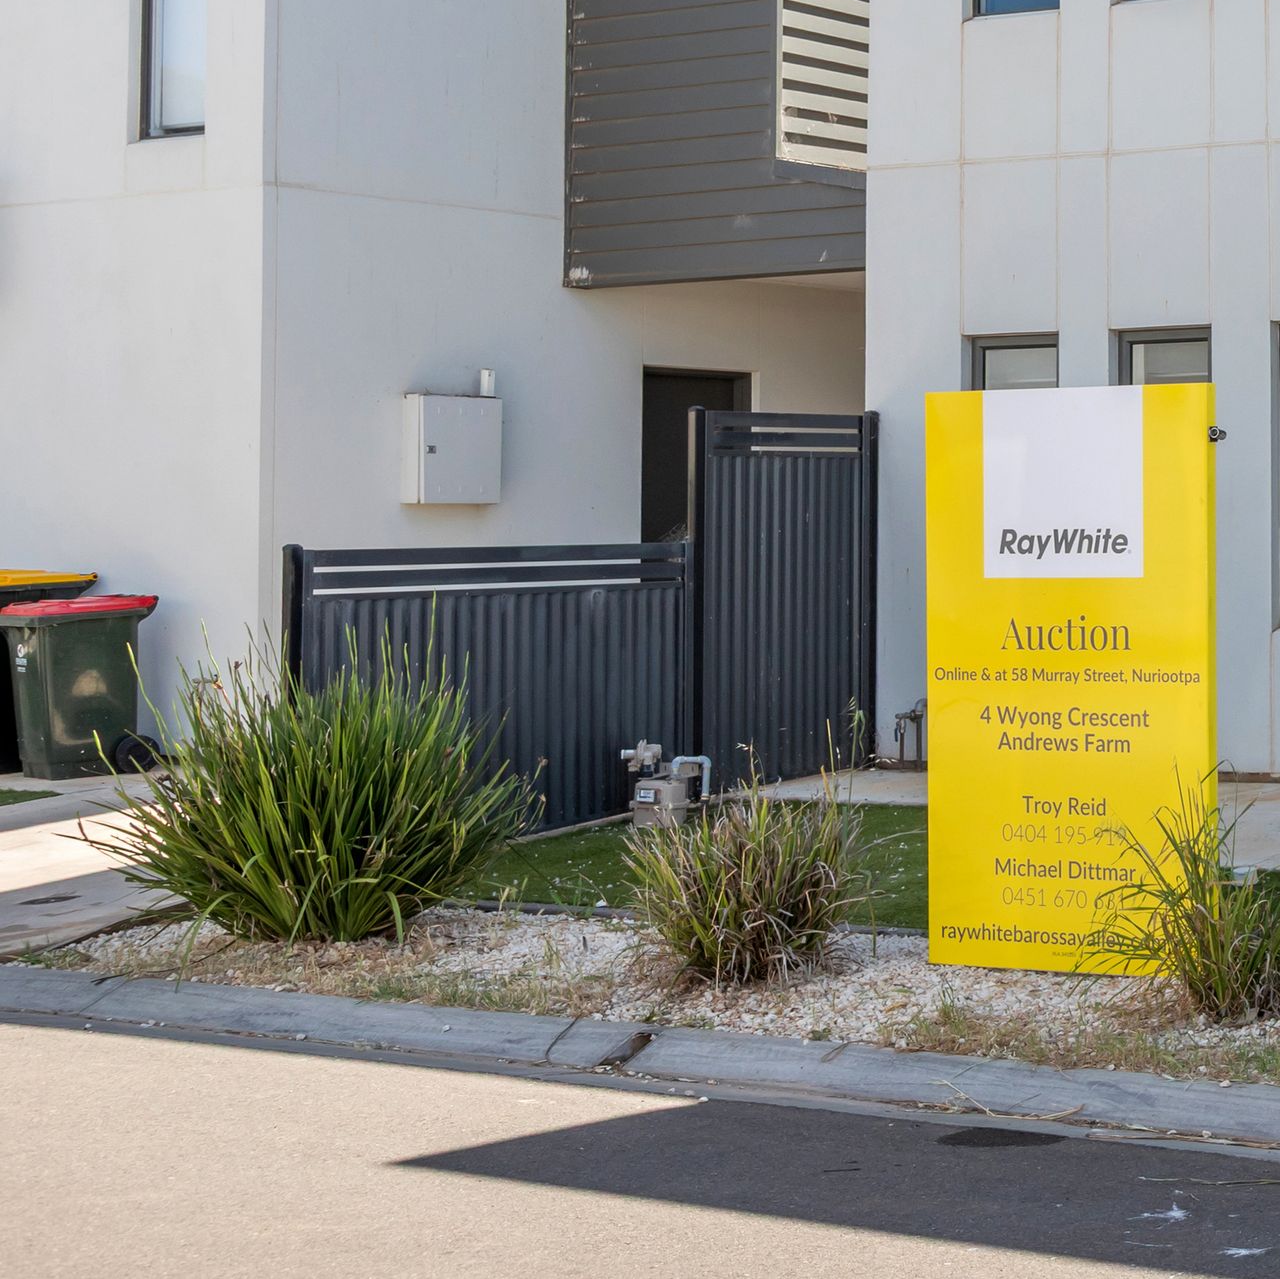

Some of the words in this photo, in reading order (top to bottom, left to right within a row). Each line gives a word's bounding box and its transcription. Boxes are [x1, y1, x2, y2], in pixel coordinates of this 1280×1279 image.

[1001, 615, 1132, 651] Auction
[934, 667, 977, 682] Online
[981, 667, 991, 681] &
[994, 668, 1008, 682] at
[1011, 668, 1028, 682] 58
[1032, 669, 1079, 685] Murray
[1084, 669, 1128, 684] Street,
[1132, 669, 1200, 685] Nuriootpa
[980, 706, 992, 724] 4
[996, 706, 1062, 729] Wyong
[1067, 707, 1150, 727] Crescent
[997, 732, 1079, 752] Andrews
[1084, 734, 1131, 753] Farm
[1022, 796, 1062, 818] Troy
[1068, 797, 1107, 816] Reid
[1001, 823, 1048, 844] 0404
[1054, 825, 1087, 846] 195
[994, 858, 1062, 878] Michael
[1068, 860, 1136, 882] Dittmar
[1002, 886, 1046, 907] 0451
[1053, 889, 1088, 909] 670
